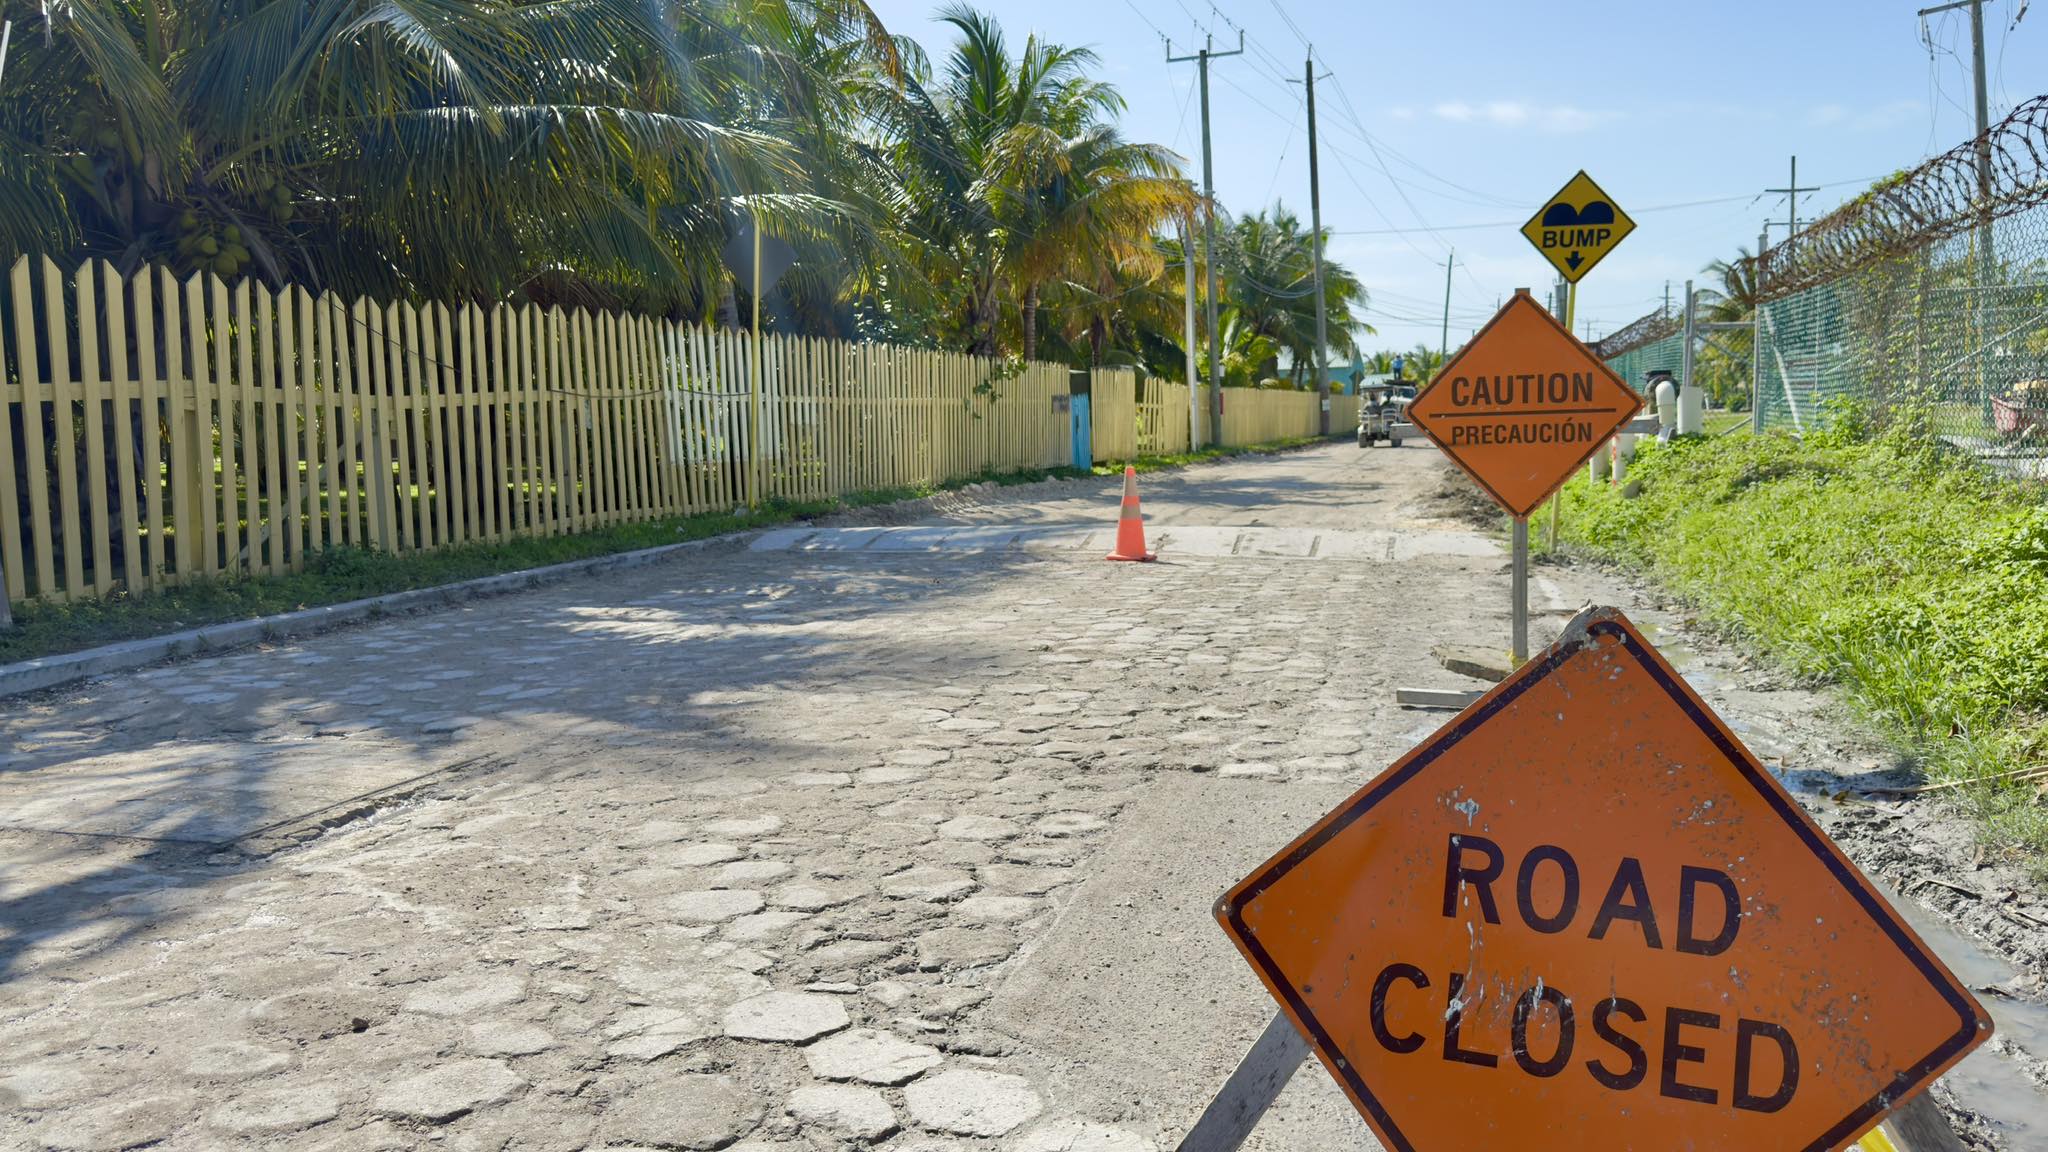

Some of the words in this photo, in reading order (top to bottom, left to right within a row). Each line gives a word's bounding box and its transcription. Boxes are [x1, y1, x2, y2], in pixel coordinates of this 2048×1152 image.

[1543, 229, 1611, 249] BUMP
[1452, 373, 1593, 406] CAUTION
[1453, 418, 1592, 446] PRECAUCIÓN
[1442, 833, 1742, 957] ROAD
[1371, 963, 1800, 1114] CLOSED
